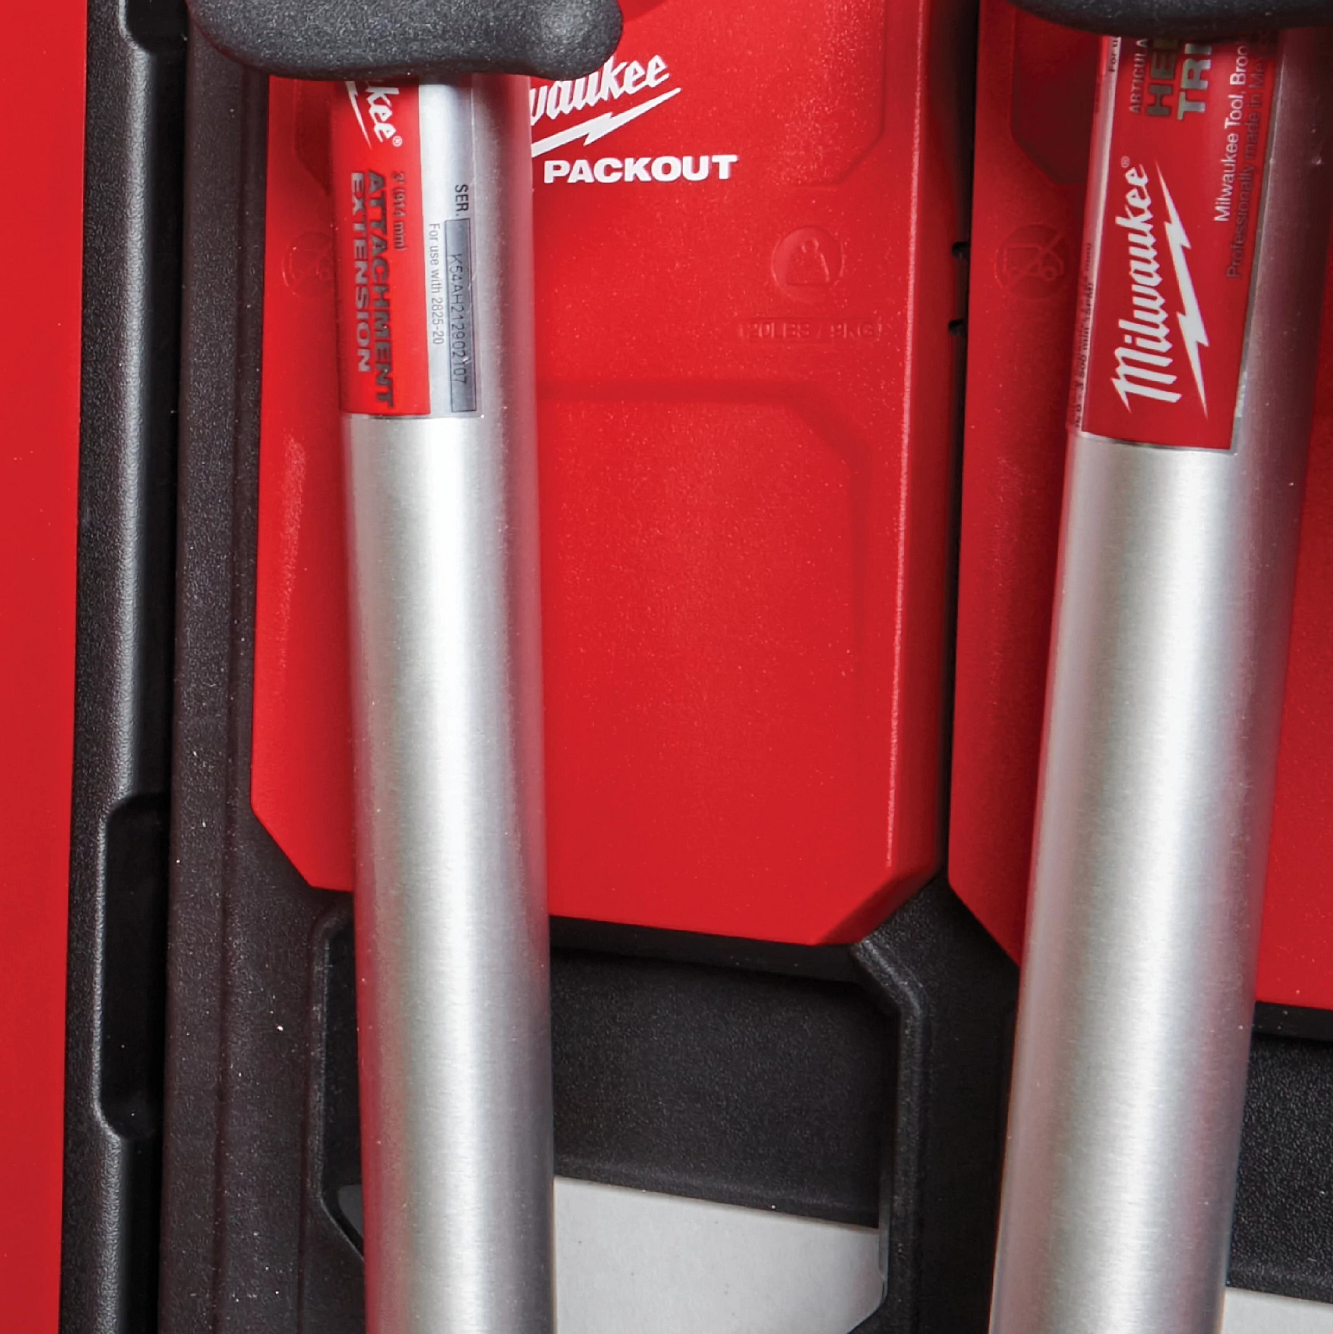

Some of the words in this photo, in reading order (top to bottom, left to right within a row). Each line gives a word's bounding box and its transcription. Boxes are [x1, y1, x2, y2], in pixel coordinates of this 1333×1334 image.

[530, 55, 670, 126] aukee
[1128, 37, 1148, 114] ARTICULA
[1224, 91, 1246, 130] Tool,
[1239, 112, 1260, 160] made
[544, 154, 738, 184] PACKOUT
[1214, 133, 1239, 222] Milwaukee
[454, 184, 470, 217] SER.
[1226, 164, 1258, 280] Professionally
[428, 223, 441, 242] For
[429, 246, 440, 265] use
[350, 171, 371, 373] EXTENSION
[367, 169, 393, 408] ATTACHMENT
[430, 270, 443, 293] with
[1111, 163, 1182, 414] Milwaukee
[431, 297, 445, 345] 2825-20
